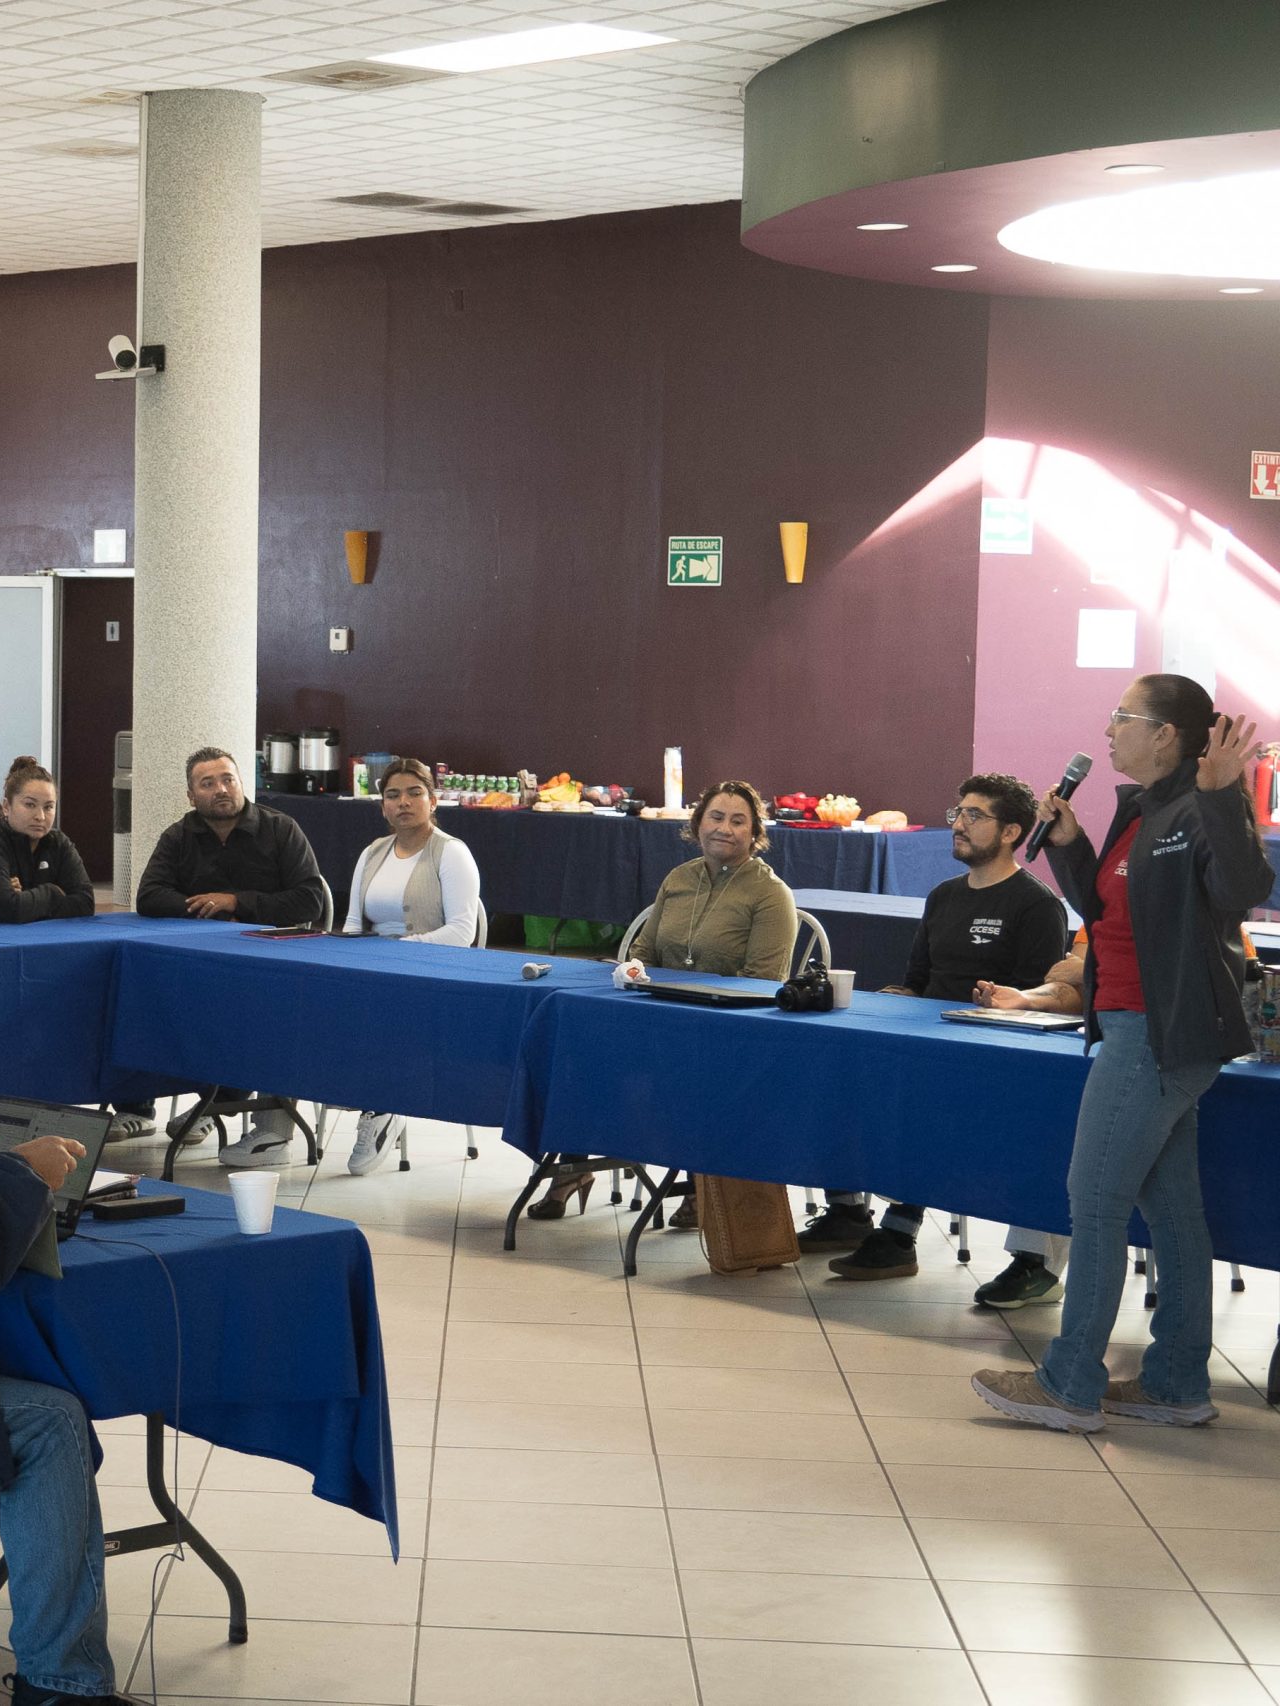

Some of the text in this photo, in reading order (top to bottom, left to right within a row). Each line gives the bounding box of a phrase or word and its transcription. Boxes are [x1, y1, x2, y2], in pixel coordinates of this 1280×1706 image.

[671, 541, 719, 550] RUTA DE ESCAPE
[969, 926, 1001, 936] CICESE
